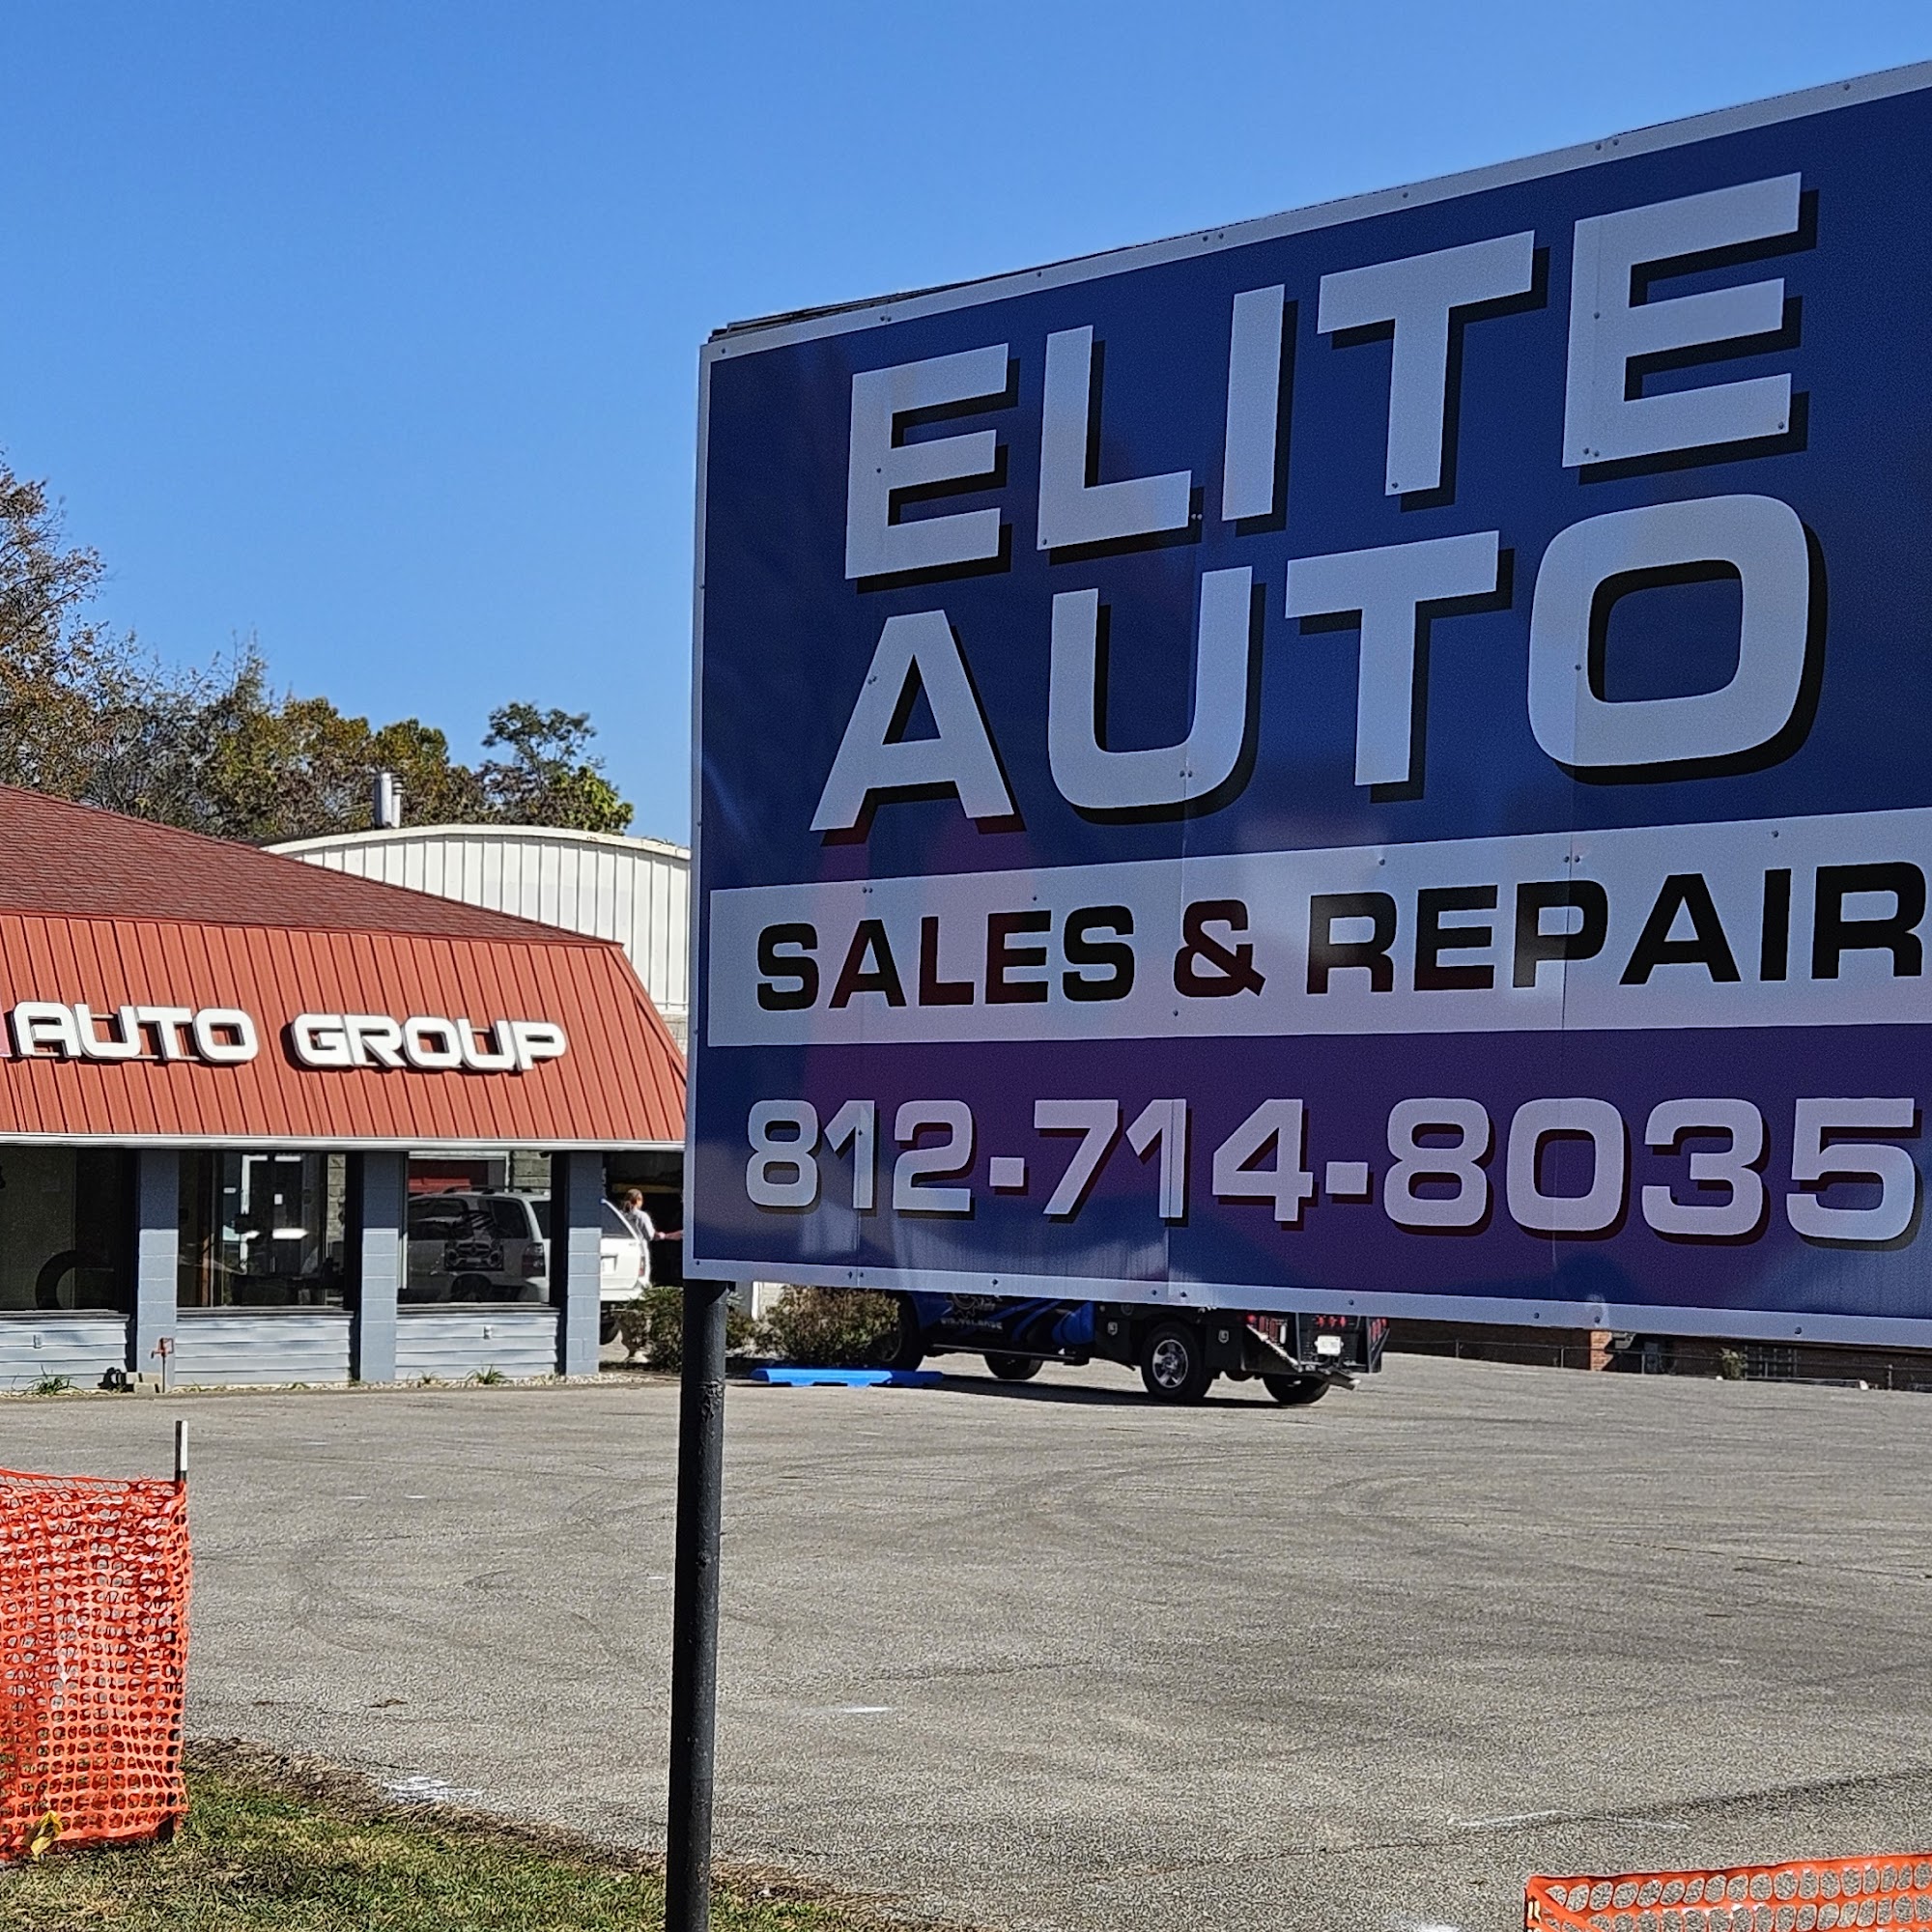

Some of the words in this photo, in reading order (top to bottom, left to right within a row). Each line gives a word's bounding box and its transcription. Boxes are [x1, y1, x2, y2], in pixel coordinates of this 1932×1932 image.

[846, 172, 1808, 585] ELITE
[810, 495, 1819, 833] AUTO
[756, 905, 1135, 1011] SALES
[1174, 899, 1265, 998] &
[1306, 862, 1926, 995] REPAIR
[14, 1001, 258, 1062] AUTO
[292, 1013, 567, 1071] GROUP
[746, 1097, 1917, 1242] 812-714-8035
